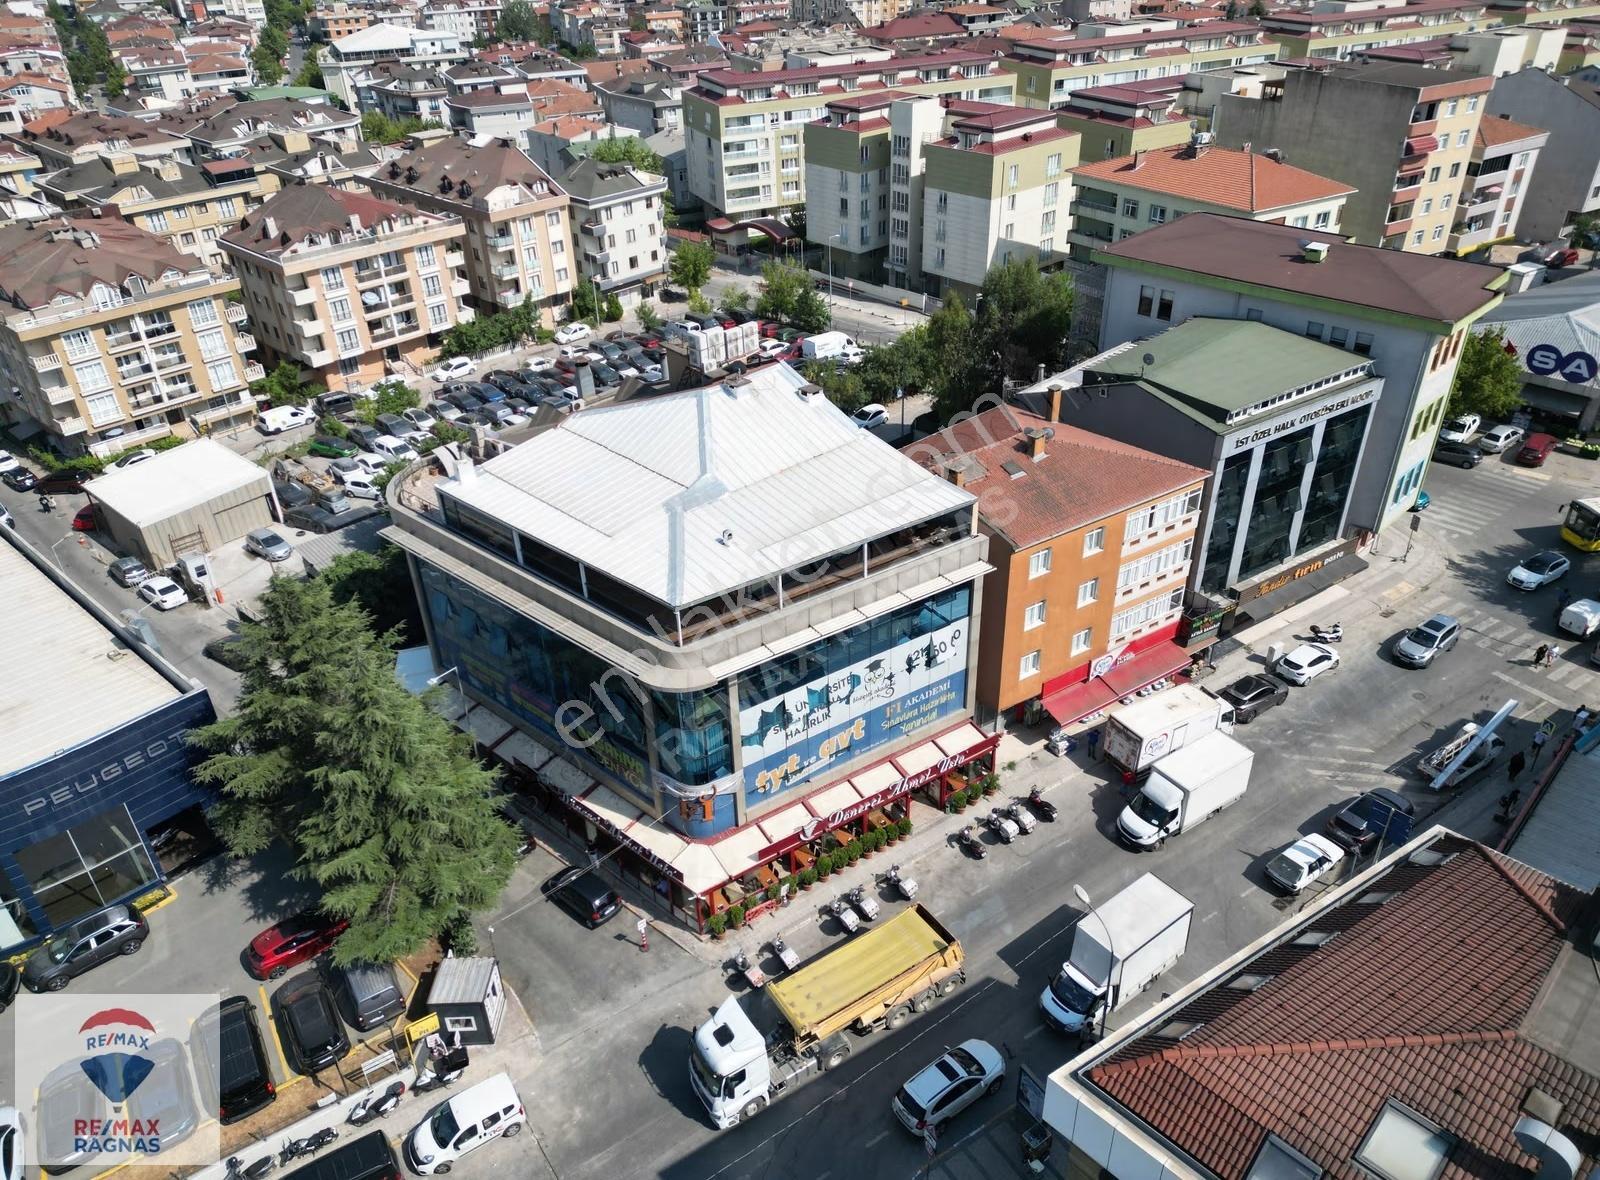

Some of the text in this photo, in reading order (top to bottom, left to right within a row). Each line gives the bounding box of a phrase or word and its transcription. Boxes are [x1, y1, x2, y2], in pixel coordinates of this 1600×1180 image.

[1532, 350, 1590, 379] SA
[1251, 429, 1273, 443] ÖZEL
[1274, 418, 1297, 434] HALK
[23, 728, 188, 816] PEUGEOT
[755, 753, 801, 794] tyt
[803, 755, 817, 767] ve
[828, 794, 885, 829] Dönerci
[887, 769, 937, 800] Ahmet
